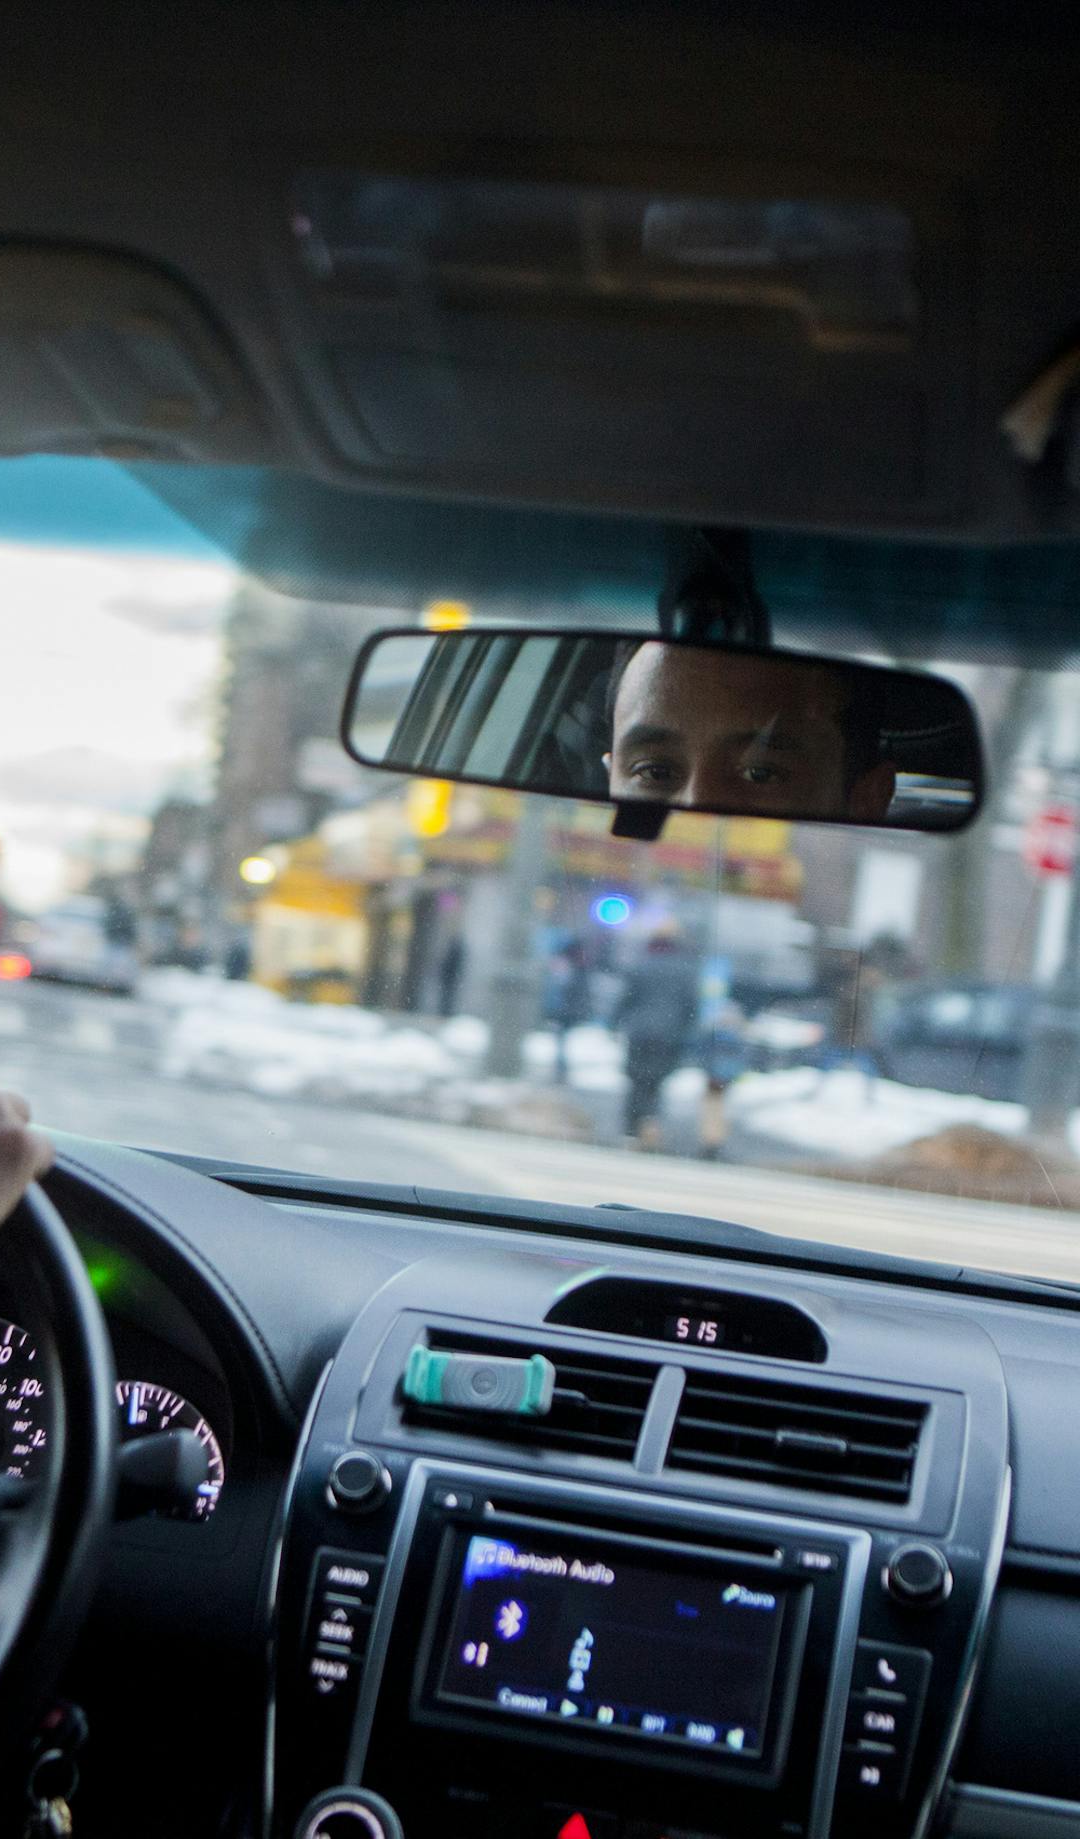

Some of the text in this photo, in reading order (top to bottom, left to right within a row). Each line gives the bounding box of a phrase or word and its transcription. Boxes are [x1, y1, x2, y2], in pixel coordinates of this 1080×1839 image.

[327, 1565, 370, 1588] AUDIO
[497, 1545, 616, 1585] Bluetooth Audio
[738, 1586, 776, 1609] Source
[319, 1620, 354, 1641] SEEK
[311, 1658, 349, 1680] TRACK
[498, 1687, 548, 1714] Connect
[864, 1711, 896, 1733] CAR
